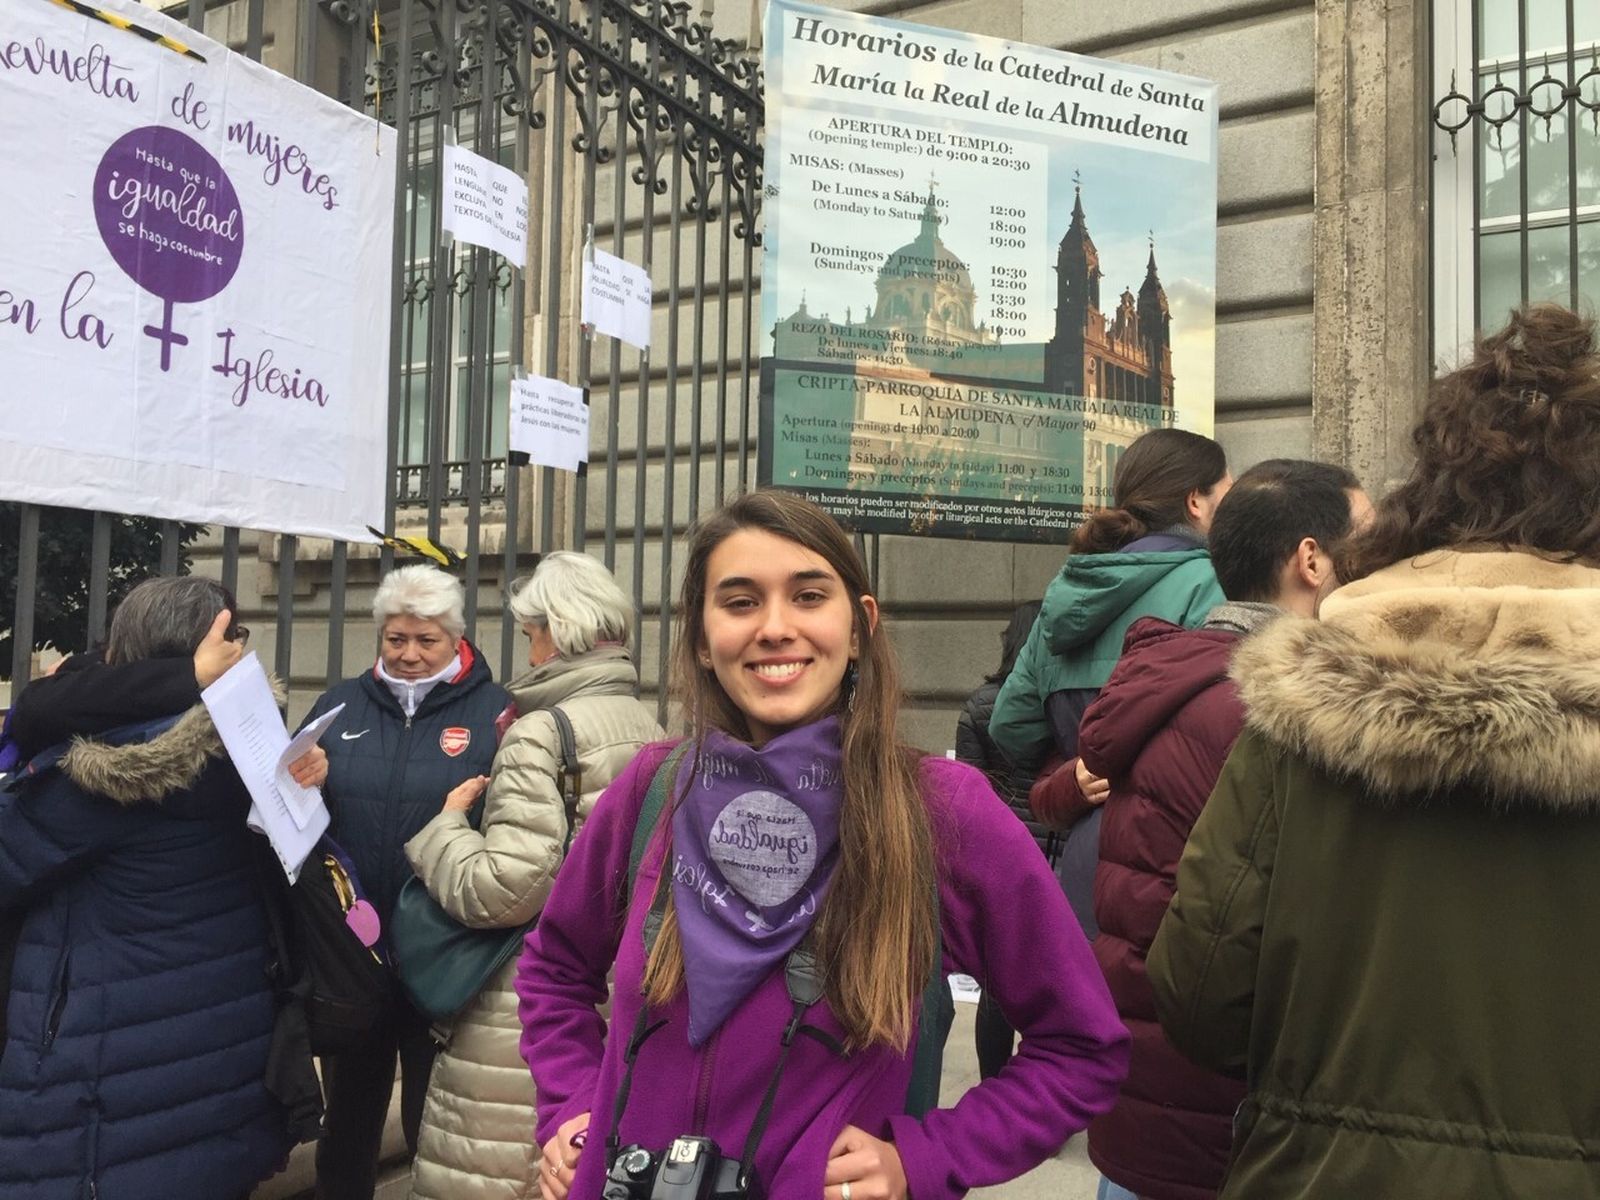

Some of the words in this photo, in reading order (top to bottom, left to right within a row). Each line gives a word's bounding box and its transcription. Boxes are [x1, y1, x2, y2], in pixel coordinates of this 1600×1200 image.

[792, 16, 937, 62] Horarios
[943, 48, 968, 68] de
[974, 51, 994, 72] la
[999, 55, 1105, 93] Catedral
[1110, 78, 1134, 98] de
[1138, 81, 1206, 112] Santa
[811, 63, 897, 96] María
[904, 80, 925, 100] la
[932, 82, 990, 111] Real
[995, 96, 1020, 115] de
[1024, 101, 1045, 120] la
[1048, 101, 1190, 146] Almudena
[0, 36, 139, 103] evuelta
[171, 82, 211, 130] de
[228, 120, 340, 211] mujeres
[828, 117, 912, 139] APERTURA
[916, 127, 946, 144] DEL
[948, 133, 1015, 155] TEMPLO:
[808, 129, 868, 149] (Opening
[926, 144, 943, 157] de
[946, 150, 978, 163] 9:00
[981, 155, 989, 164] a
[992, 156, 1031, 171] 20:30
[136, 147, 174, 173] Hasta
[180, 166, 201, 187] que
[205, 175, 216, 190] la
[454, 162, 478, 178] HASTA
[492, 180, 508, 195] QUE
[789, 153, 845, 171] MISAS:
[848, 161, 905, 180] (Masses)
[107, 170, 239, 242] igualdad
[492, 195, 504, 206] NO
[811, 179, 831, 193] De
[835, 184, 879, 200] Lunes
[882, 190, 890, 201] a
[893, 188, 949, 208] Sábado:
[813, 198, 870, 218] (Monday
[873, 206, 886, 217] to
[889, 206, 949, 226] Saturday)
[989, 204, 1026, 219] 12:00
[989, 220, 1027, 235] 18:00
[989, 234, 1026, 249] 19:00
[118, 221, 135, 238] se
[139, 225, 169, 253] haga
[170, 240, 223, 266] costumbre
[810, 242, 884, 262] Domingos
[887, 253, 896, 265] y
[899, 254, 971, 273] preceptos:
[814, 256, 874, 275] (Sundays
[877, 265, 900, 277] and
[903, 268, 960, 286] precepts)
[991, 265, 1027, 279] 10:30
[991, 277, 1027, 291] 12:00
[990, 292, 1026, 306] 13:30
[990, 307, 1027, 321] 18:00
[0, 290, 41, 334] en
[60, 270, 114, 349] la
[212, 328, 330, 407] Iglesia
[792, 322, 827, 335] REZO
[830, 326, 856, 338] DEL
[858, 329, 918, 344] ROSARIO:
[818, 335, 834, 348] De
[837, 338, 869, 350] lunes
[882, 340, 929, 357] Viernes:
[817, 346, 871, 362] Sábados:
[798, 375, 963, 402] CRIPTA-PARROQUIA
[968, 389, 989, 402] DE
[992, 391, 1043, 409] SANTA
[1046, 396, 1099, 414] MARÍA
[1102, 404, 1120, 417] LA
[1123, 406, 1158, 421] REAL
[1161, 409, 1180, 423] DE
[782, 414, 837, 429] Apertura
[893, 423, 908, 434] de
[911, 424, 939, 436] 10:00
[950, 426, 980, 439] 20:00
[900, 403, 920, 416] LA
[924, 405, 1015, 425] ALMUDENA
[1037, 415, 1079, 432] Mayor
[1082, 419, 1096, 432] 90
[781, 430, 818, 444] Misas
[804, 465, 867, 482] Domingos
[869, 472, 877, 484] y
[880, 472, 936, 486] preceptos
[805, 449, 842, 462] Lunes
[855, 451, 899, 466] Sábado
[997, 463, 1025, 475] 11:00
[1030, 467, 1037, 477] y
[1043, 466, 1070, 478] 18:30
[805, 491, 819, 503] los
[820, 493, 858, 505] horarios
[861, 497, 893, 509] pueden
[895, 501, 909, 509] ser
[910, 500, 962, 512] modificados
[964, 502, 979, 513] por
[981, 504, 1002, 514] otros
[1004, 506, 1025, 516] actos
[1066, 510, 1073, 519] o
[833, 508, 853, 518] may
[854, 505, 866, 517] be
[867, 507, 906, 519] modified
[908, 509, 919, 521] by
[921, 511, 944, 522] other
[945, 511, 984, 524] liturgical
[985, 516, 1002, 525] acts
[1003, 517, 1014, 525] or
[1014, 516, 1028, 526] the
[1029, 517, 1069, 529] Cathedral
